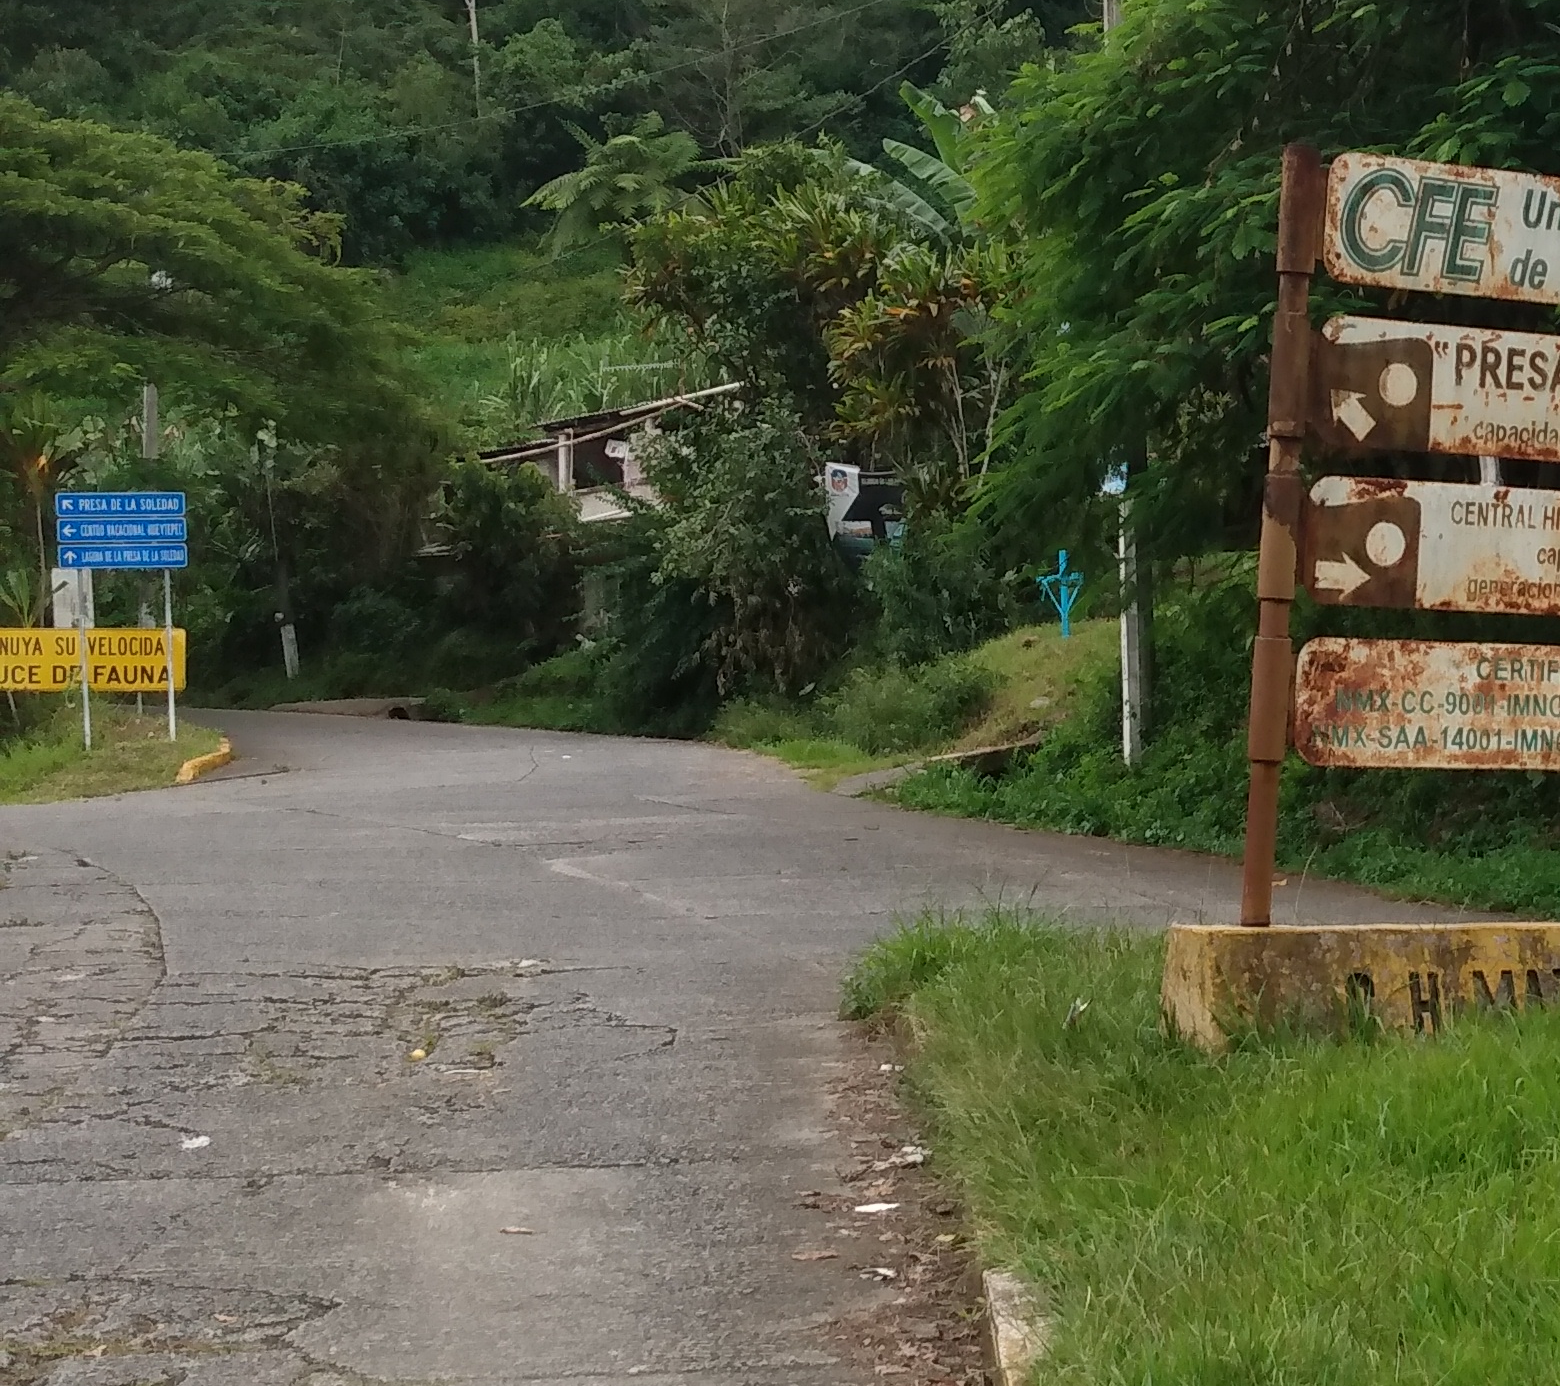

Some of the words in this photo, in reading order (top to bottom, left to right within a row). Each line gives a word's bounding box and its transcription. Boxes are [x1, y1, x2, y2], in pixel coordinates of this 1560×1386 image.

[1340, 168, 1499, 284] CFE
[1510, 249, 1549, 289] de
[79, 498, 108, 511] PRESA
[111, 498, 122, 511] DE
[125, 498, 137, 511] LA
[140, 498, 179, 511] SOLEDAD
[1451, 501, 1536, 529] CENTRAL
[55, 637, 76, 656] SU
